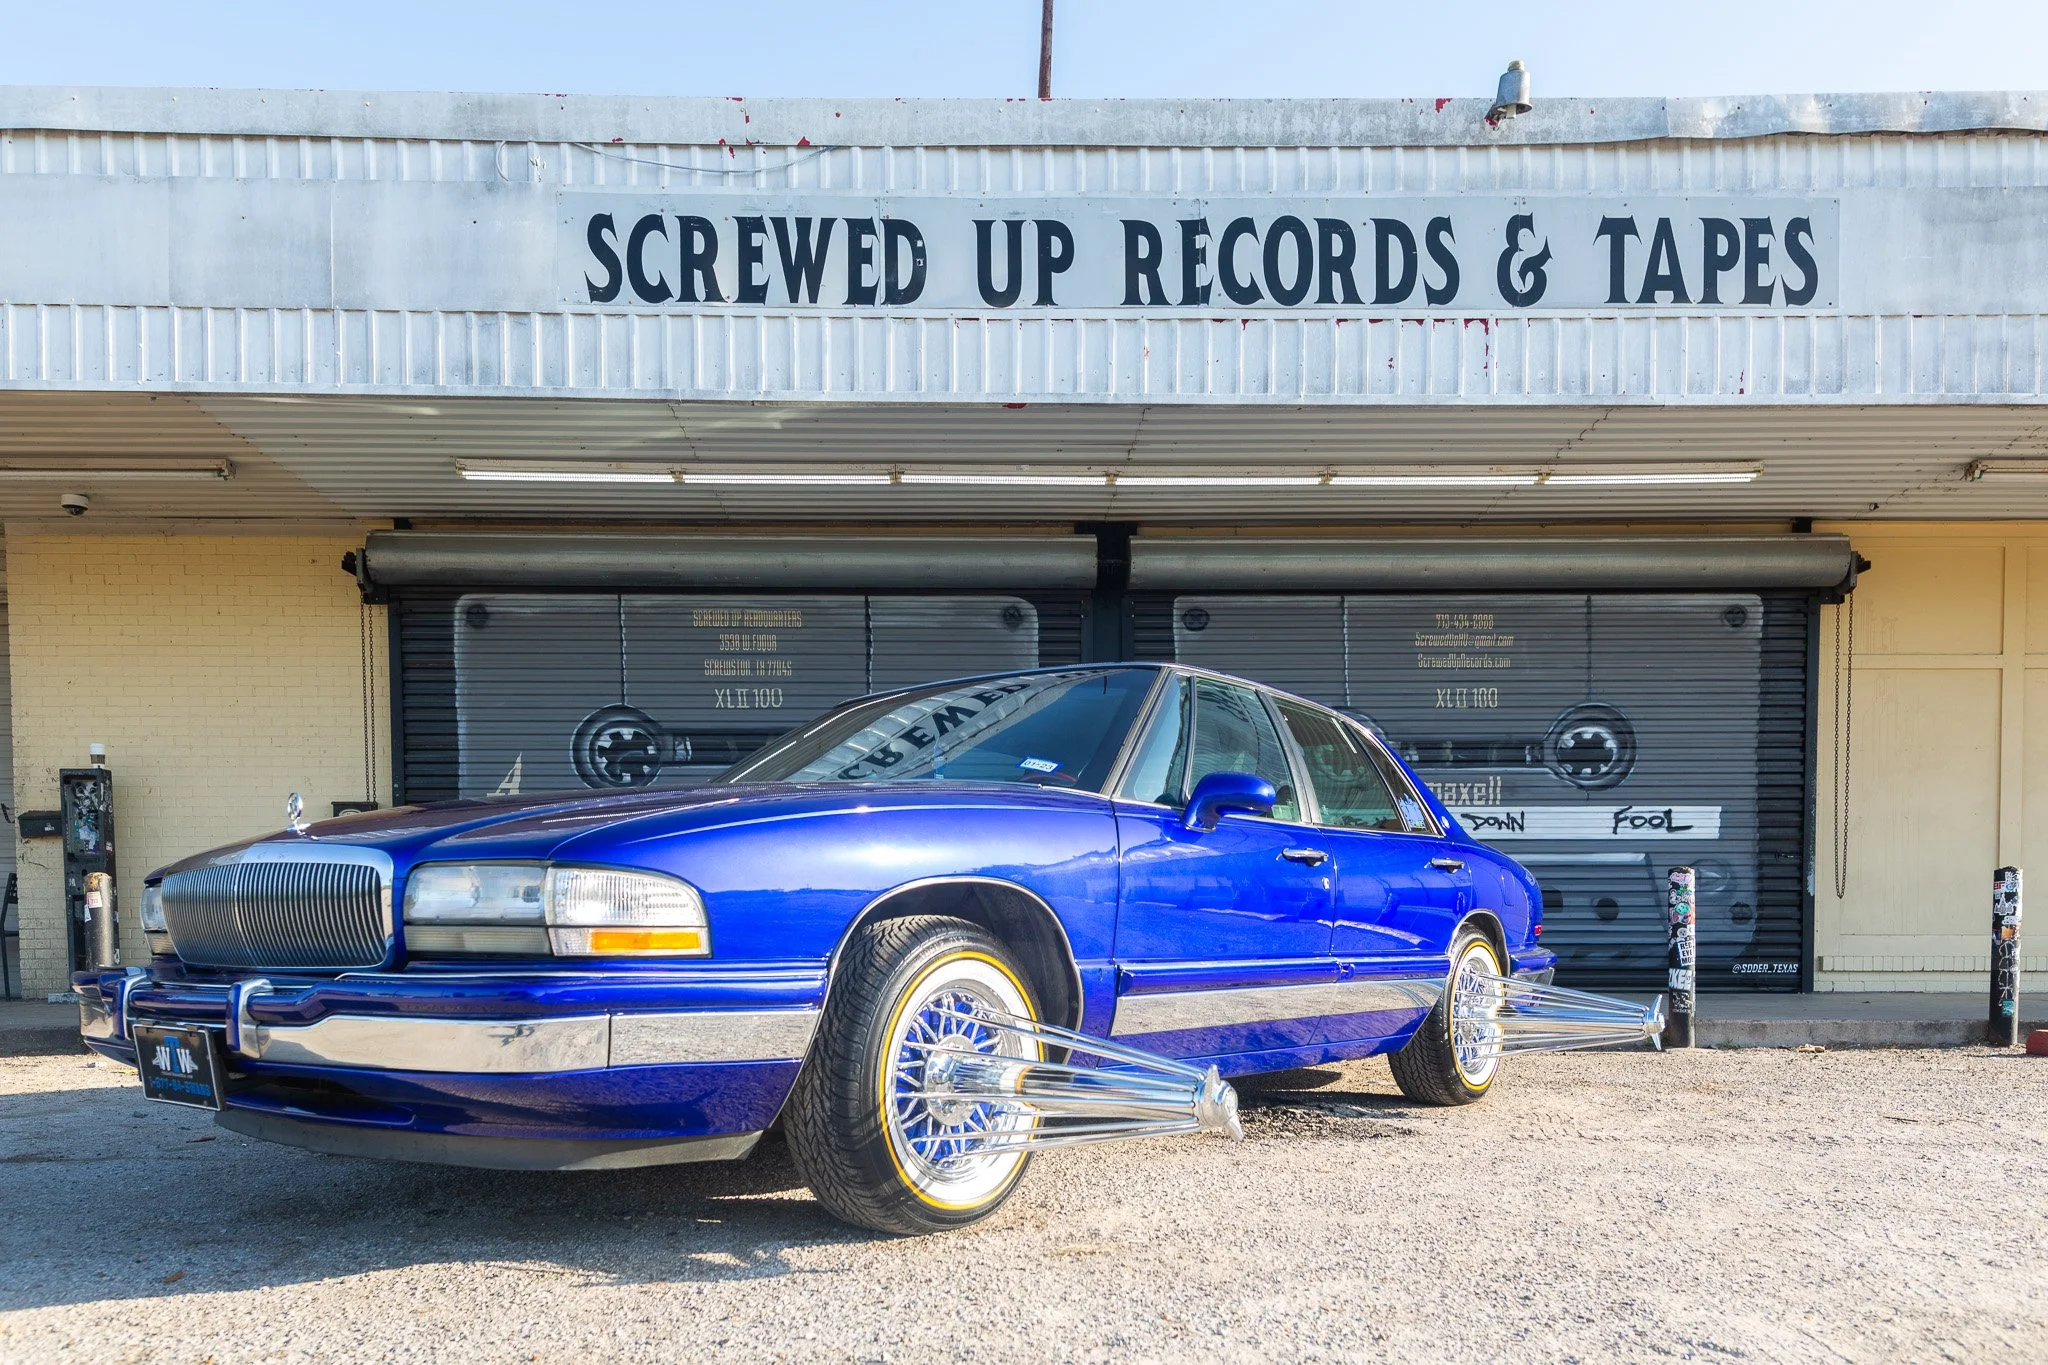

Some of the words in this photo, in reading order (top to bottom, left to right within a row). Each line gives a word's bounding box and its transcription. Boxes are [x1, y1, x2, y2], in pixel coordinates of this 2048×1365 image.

[584, 212, 927, 306] SCREWED
[971, 218, 1075, 308] UP
[1119, 214, 1460, 307] RECORDS
[1497, 212, 1553, 308] &
[1592, 213, 1819, 307] TAPES
[693, 609, 729, 627] SCREWED
[731, 610, 742, 627] UP
[752, 688, 783, 708] 100
[1472, 687, 1498, 708] 100
[1461, 810, 1525, 832] DOWN
[1612, 805, 1693, 834] FOOL
